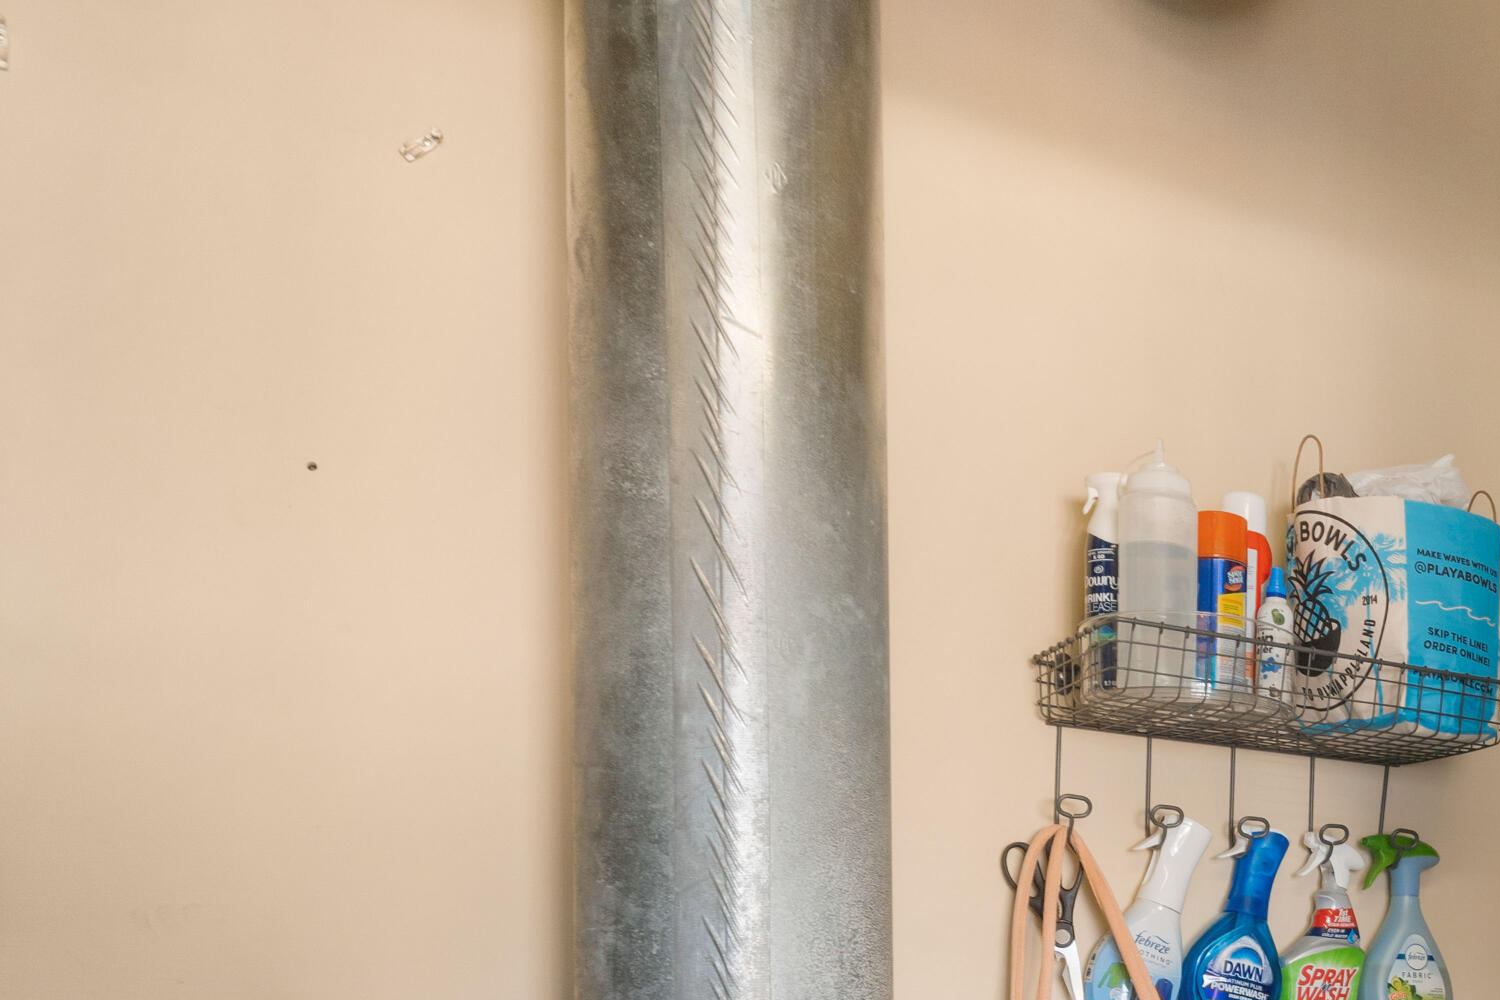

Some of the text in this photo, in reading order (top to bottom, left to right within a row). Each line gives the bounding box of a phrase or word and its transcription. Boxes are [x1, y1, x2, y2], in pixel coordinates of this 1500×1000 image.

[1299, 520, 1367, 572] BOWLS
[1416, 548, 1442, 560] MAKE
[1443, 553, 1471, 567] WAVES
[1472, 560, 1489, 574] WITH
[1414, 561, 1498, 594] @PLAYABOWLS
[1428, 626, 1489, 653] SKIP THE LINE!
[1424, 640, 1490, 667] ORDER ONLINE!
[1134, 930, 1170, 955] febreze
[1139, 949, 1171, 966] OTHING
[1223, 960, 1263, 982] DAWN
[1298, 965, 1357, 986] SPRAY
[1402, 971, 1432, 979] FABRIC
